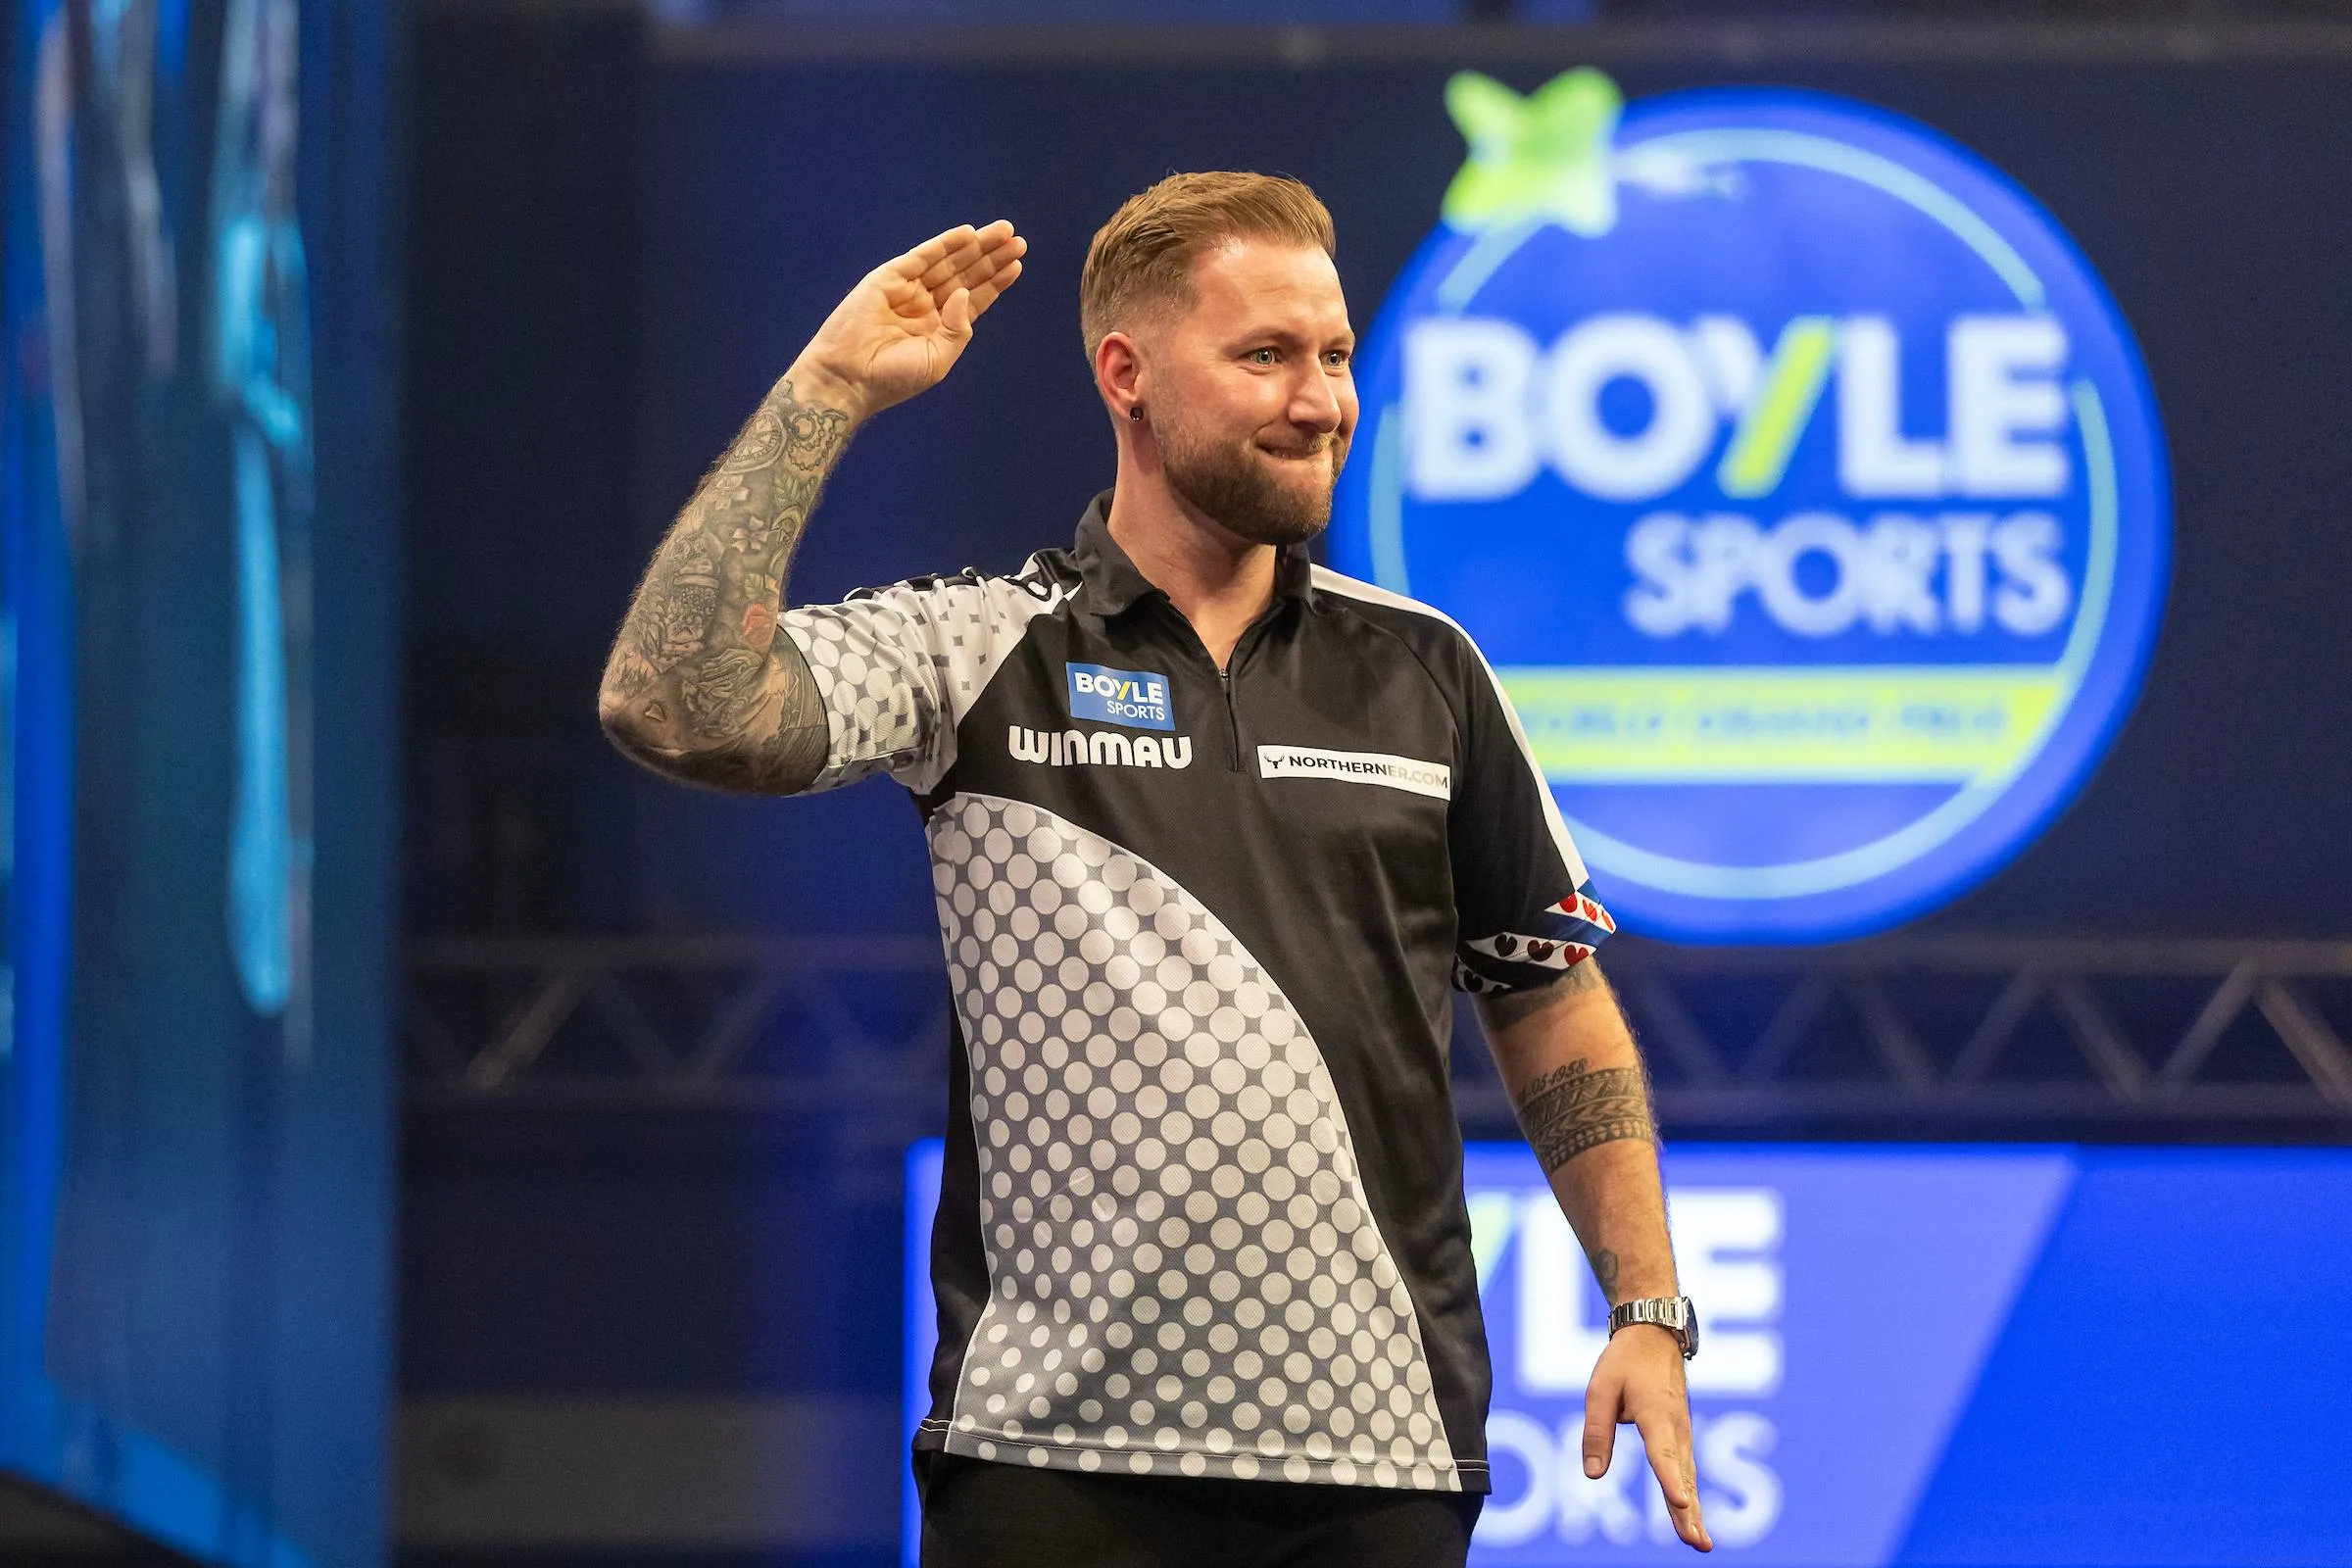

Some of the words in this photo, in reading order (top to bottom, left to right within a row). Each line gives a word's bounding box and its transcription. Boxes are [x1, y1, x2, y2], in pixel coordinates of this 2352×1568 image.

[1407, 316, 2067, 498] BOYLE
[1626, 513, 2068, 637] SPORTS
[1074, 672, 1163, 705] BOYLE
[1106, 700, 1165, 721] SPORTS
[1008, 725, 1193, 769] WINMAU
[1289, 756, 1448, 789] NORTHERNER.COM
